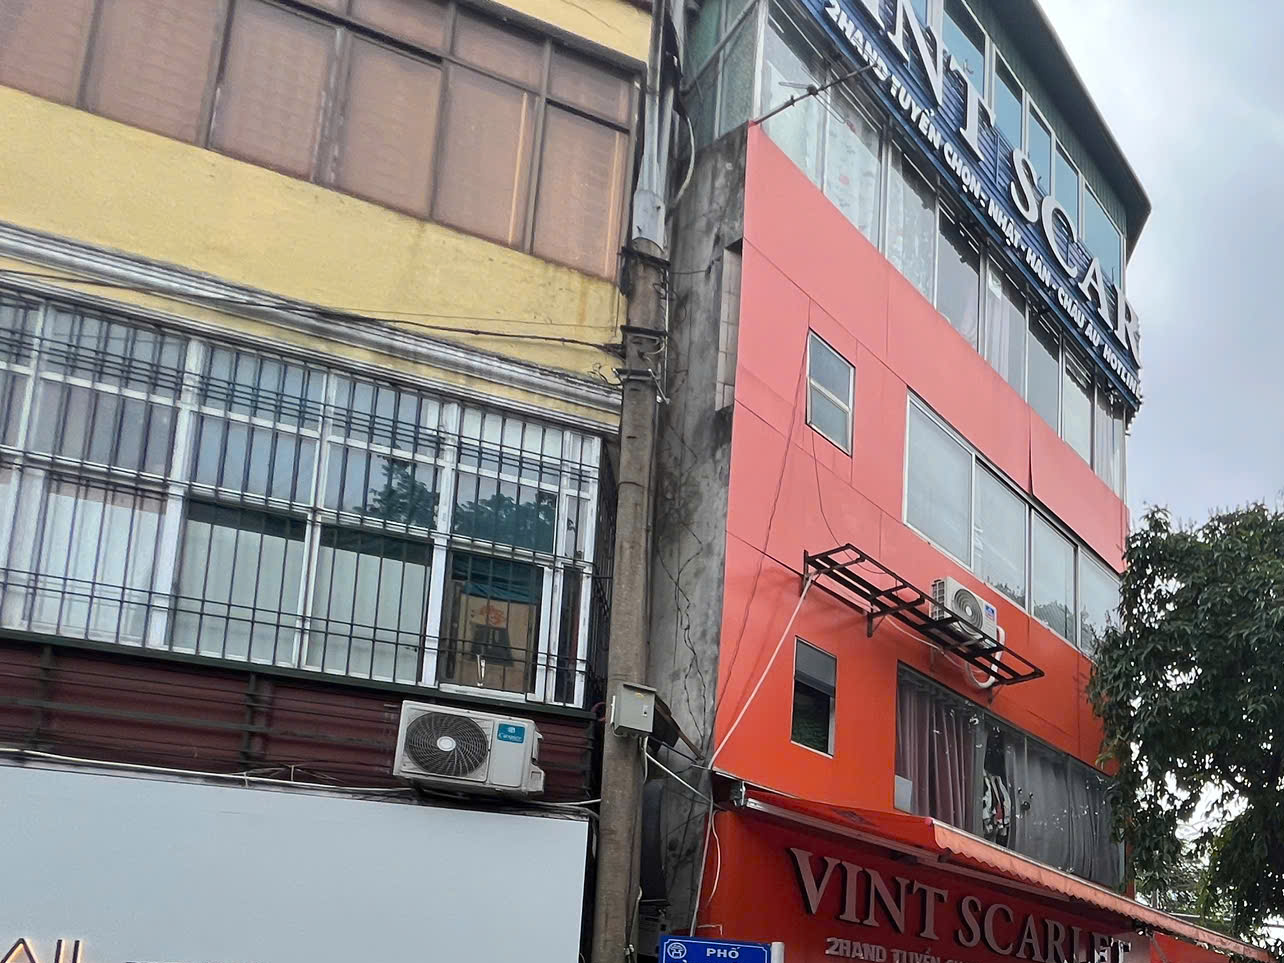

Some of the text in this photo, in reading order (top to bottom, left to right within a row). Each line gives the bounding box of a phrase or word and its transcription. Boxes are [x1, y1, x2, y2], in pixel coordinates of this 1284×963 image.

[825, 0, 889, 81] 2HAND
[789, 847, 949, 940] VINT
[706, 946, 741, 959] PHỐ
[825, 937, 888, 963] 2HAND
